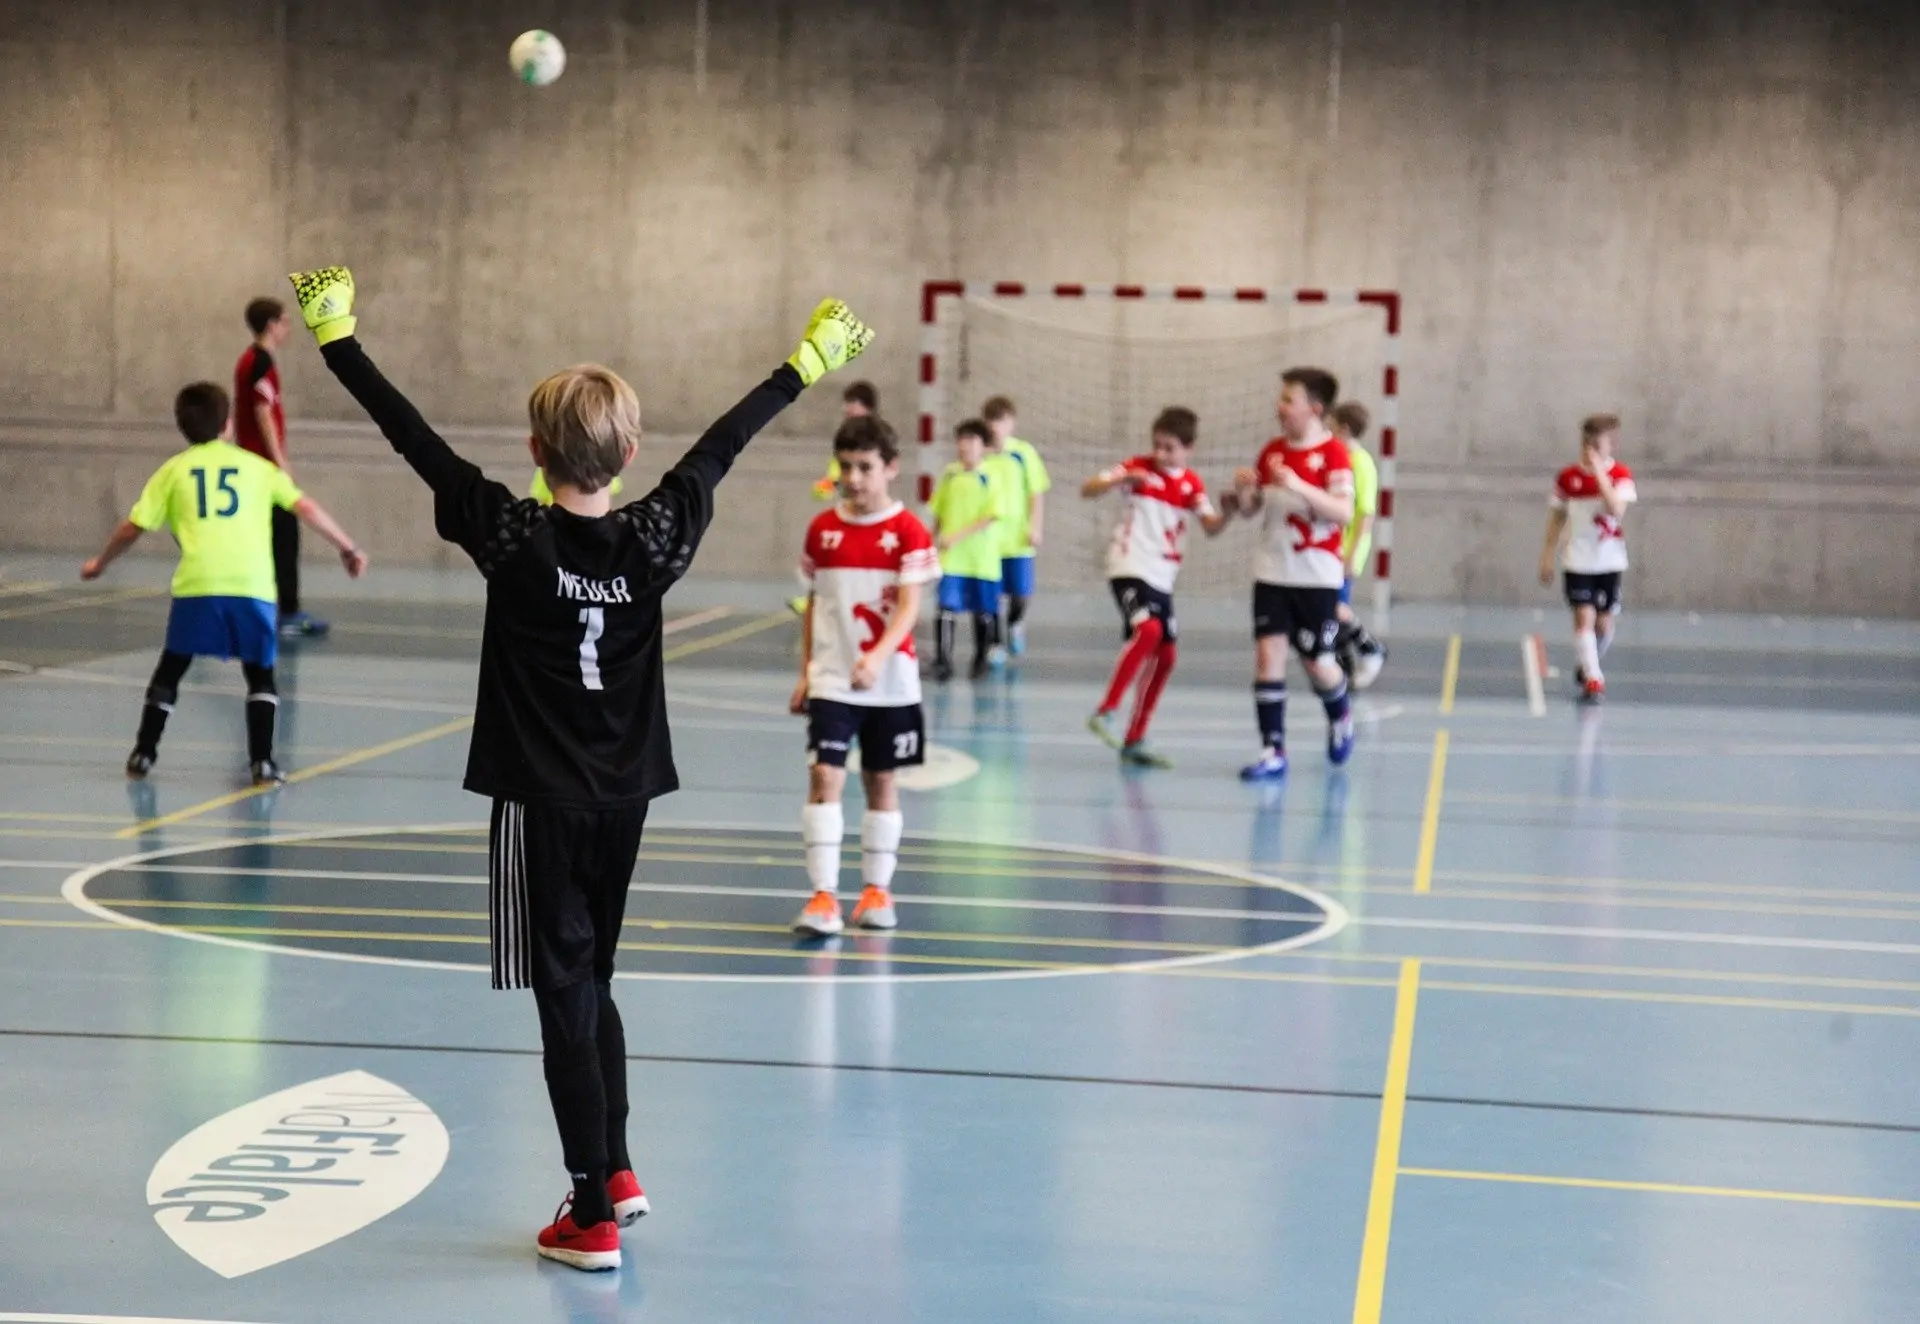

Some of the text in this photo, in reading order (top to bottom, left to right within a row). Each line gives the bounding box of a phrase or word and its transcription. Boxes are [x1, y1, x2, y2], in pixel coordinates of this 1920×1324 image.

[189, 468, 239, 518] 15
[556, 566, 632, 603] NEUER
[578, 607, 604, 690] 1
[893, 730, 918, 759] 27
